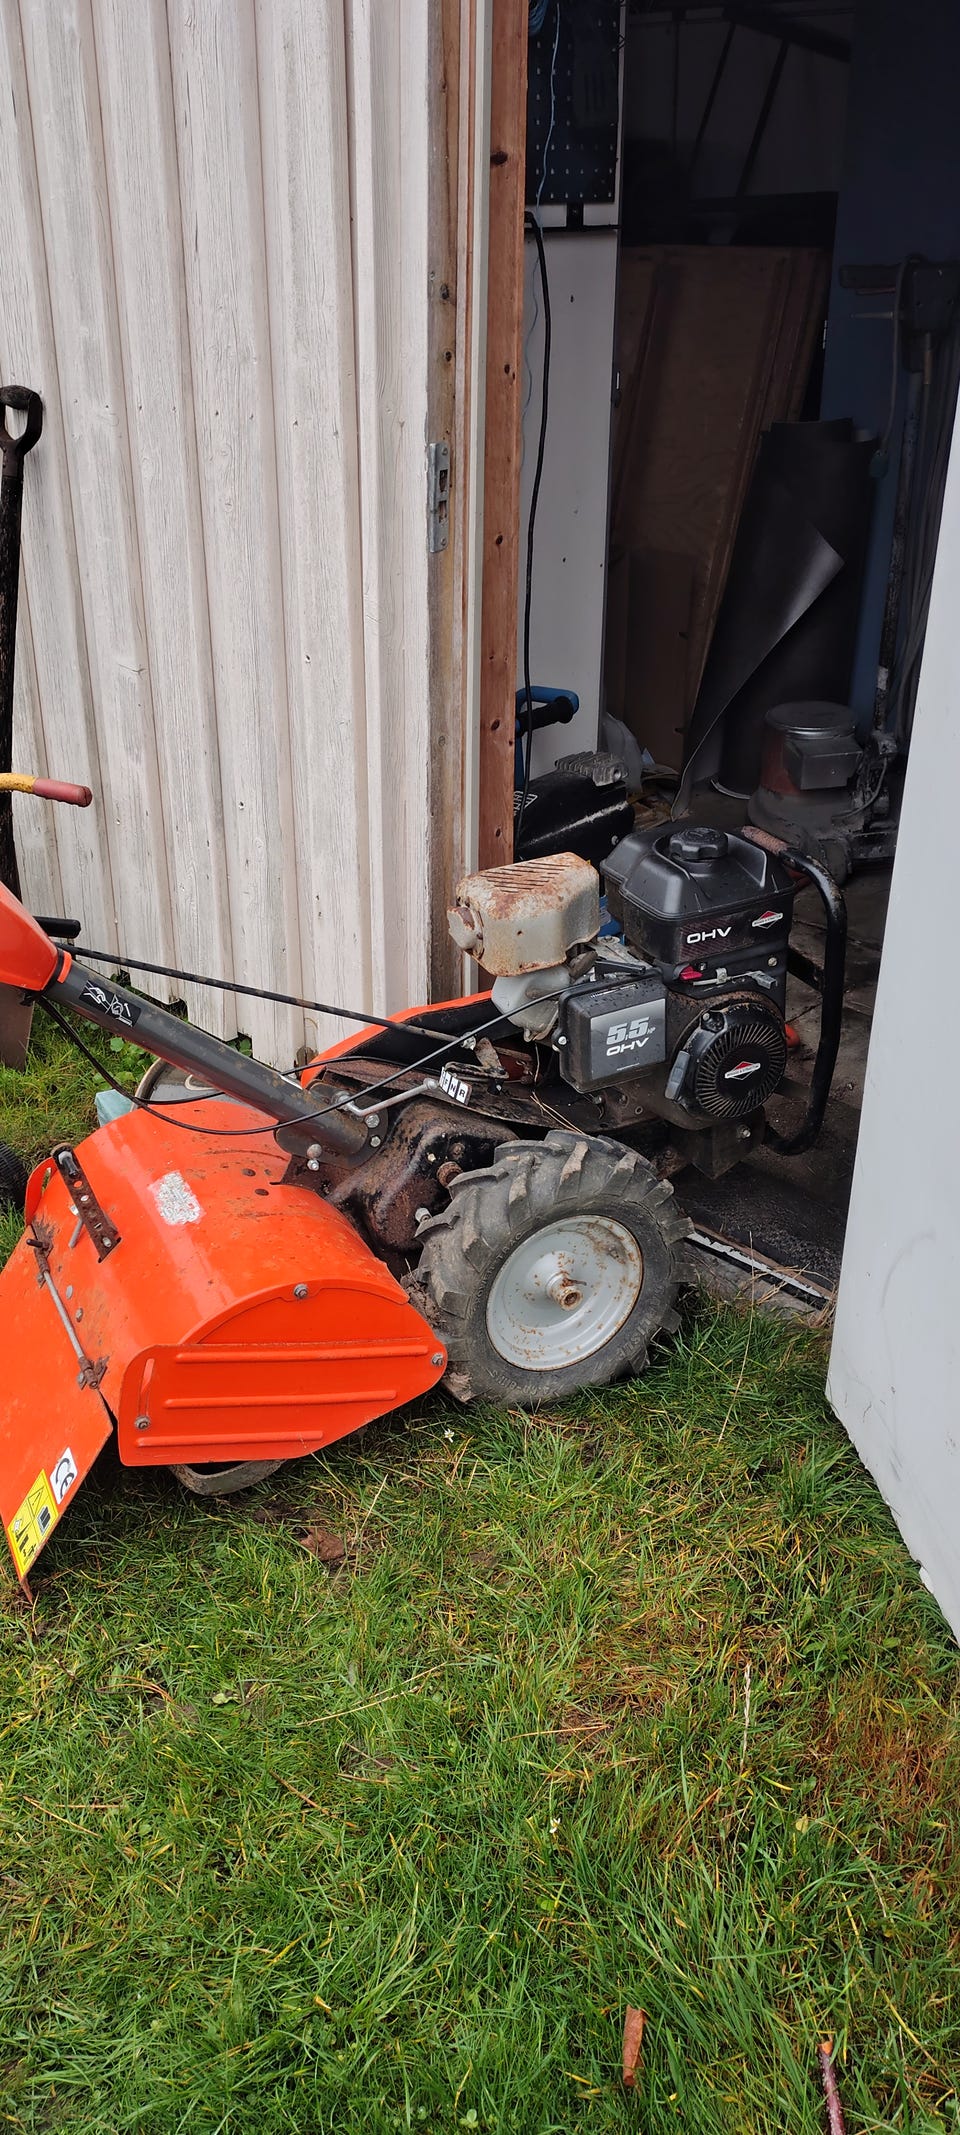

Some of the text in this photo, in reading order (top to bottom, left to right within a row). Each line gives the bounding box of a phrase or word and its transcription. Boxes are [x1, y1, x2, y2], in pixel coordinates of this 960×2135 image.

[686, 926, 732, 944] OHV
[606, 1016, 650, 1046] 5.5
[606, 1037, 649, 1056] OHV
[459, 1089, 465, 1098] R
